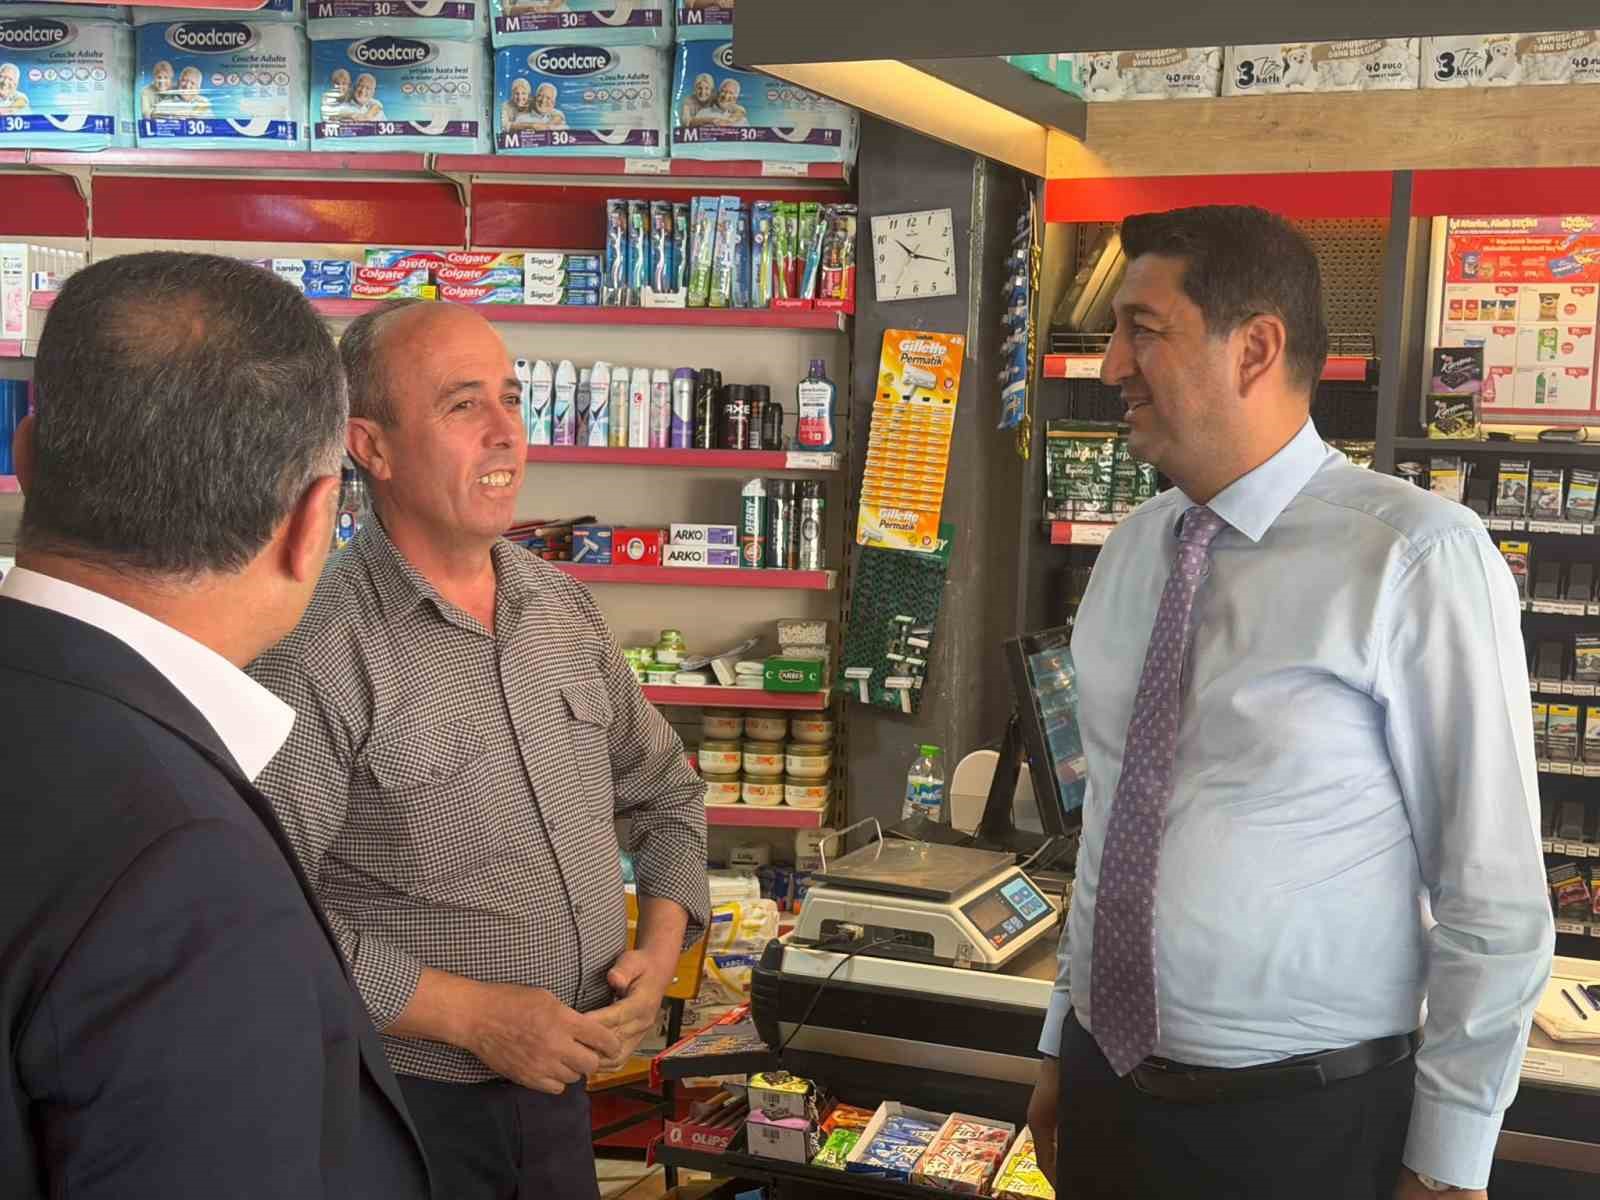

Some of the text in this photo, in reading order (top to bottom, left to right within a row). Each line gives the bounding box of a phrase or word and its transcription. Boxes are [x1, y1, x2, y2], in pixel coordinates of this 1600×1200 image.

[318, 3, 390, 17] M 30
[506, 13, 578, 31] M 30
[687, 11, 703, 24] M
[175, 28, 247, 46] Goodcare
[357, 42, 425, 61] Goodcare
[537, 52, 607, 70] Goodcare
[1366, 62, 1380, 72] 40
[1437, 52, 1455, 78] 3
[1572, 57, 1588, 68] 40
[1237, 60, 1255, 86] 3
[6, 117, 24, 131] 30
[145, 120, 205, 136] L 30
[378, 122, 395, 135] 30
[504, 130, 569, 148] M 30
[684, 127, 757, 142] M 30
[889, 220, 898, 229] 11
[906, 217, 917, 228] 12
[447, 253, 491, 265] Colgate
[531, 257, 554, 266] Signal
[359, 269, 405, 281] Colgate
[438, 268, 483, 280] Colgate
[531, 273, 555, 283] Signal
[353, 285, 390, 293] Colgate
[442, 286, 486, 298] Colgate
[530, 290, 554, 300] Signal
[898, 339, 948, 357] Gillette
[900, 352, 943, 366] Permatik
[725, 403, 750, 415] AXE
[745, 499, 757, 534] DERBY
[880, 508, 919, 524] Gillette
[878, 519, 914, 531] Permatik
[674, 530, 704, 542] ARKO
[667, 550, 702, 562] ARKO
